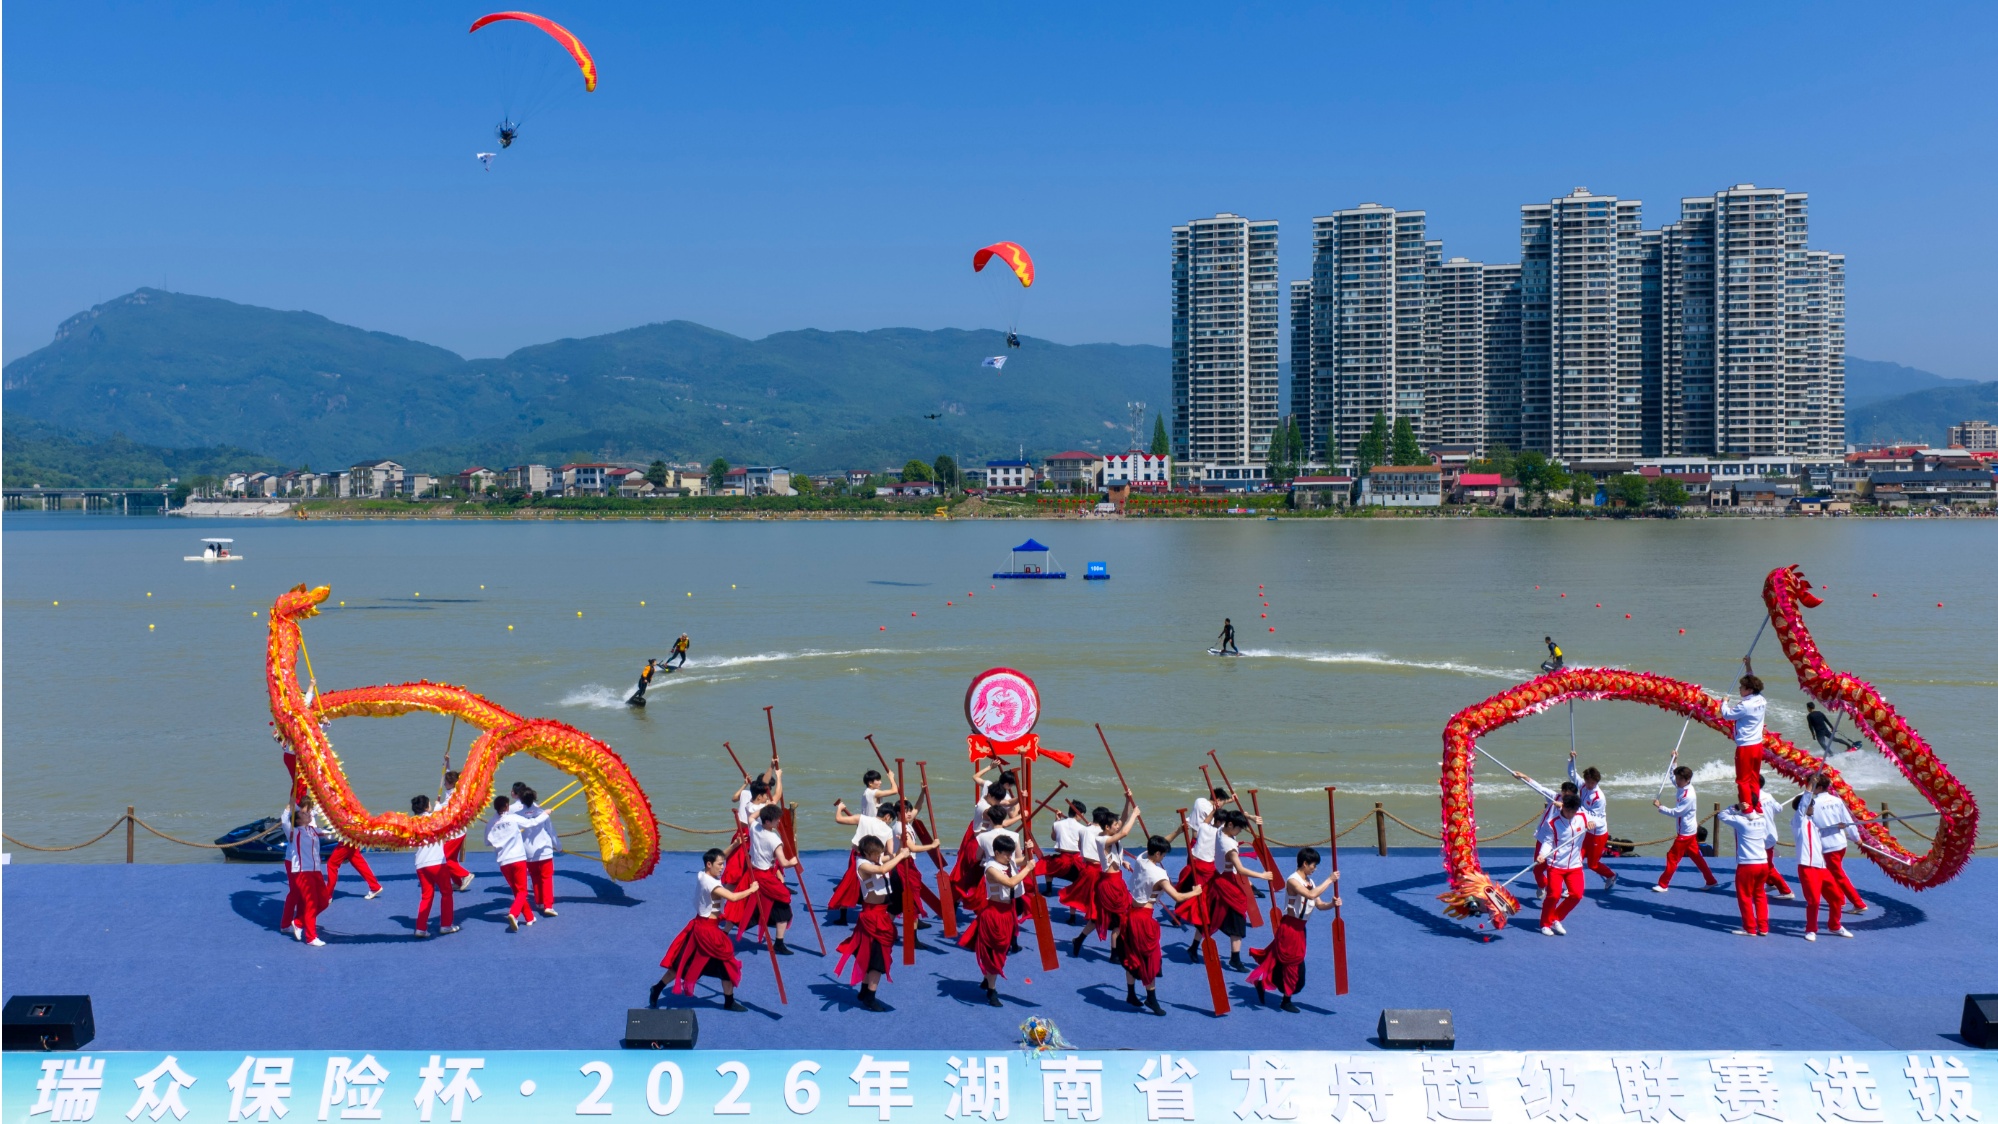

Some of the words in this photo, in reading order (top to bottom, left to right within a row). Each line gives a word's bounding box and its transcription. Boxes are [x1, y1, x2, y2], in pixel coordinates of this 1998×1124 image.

[29, 1054, 1981, 1123] 瑞众保险杯·2026年湖南省龙舟超级联赛选拔
